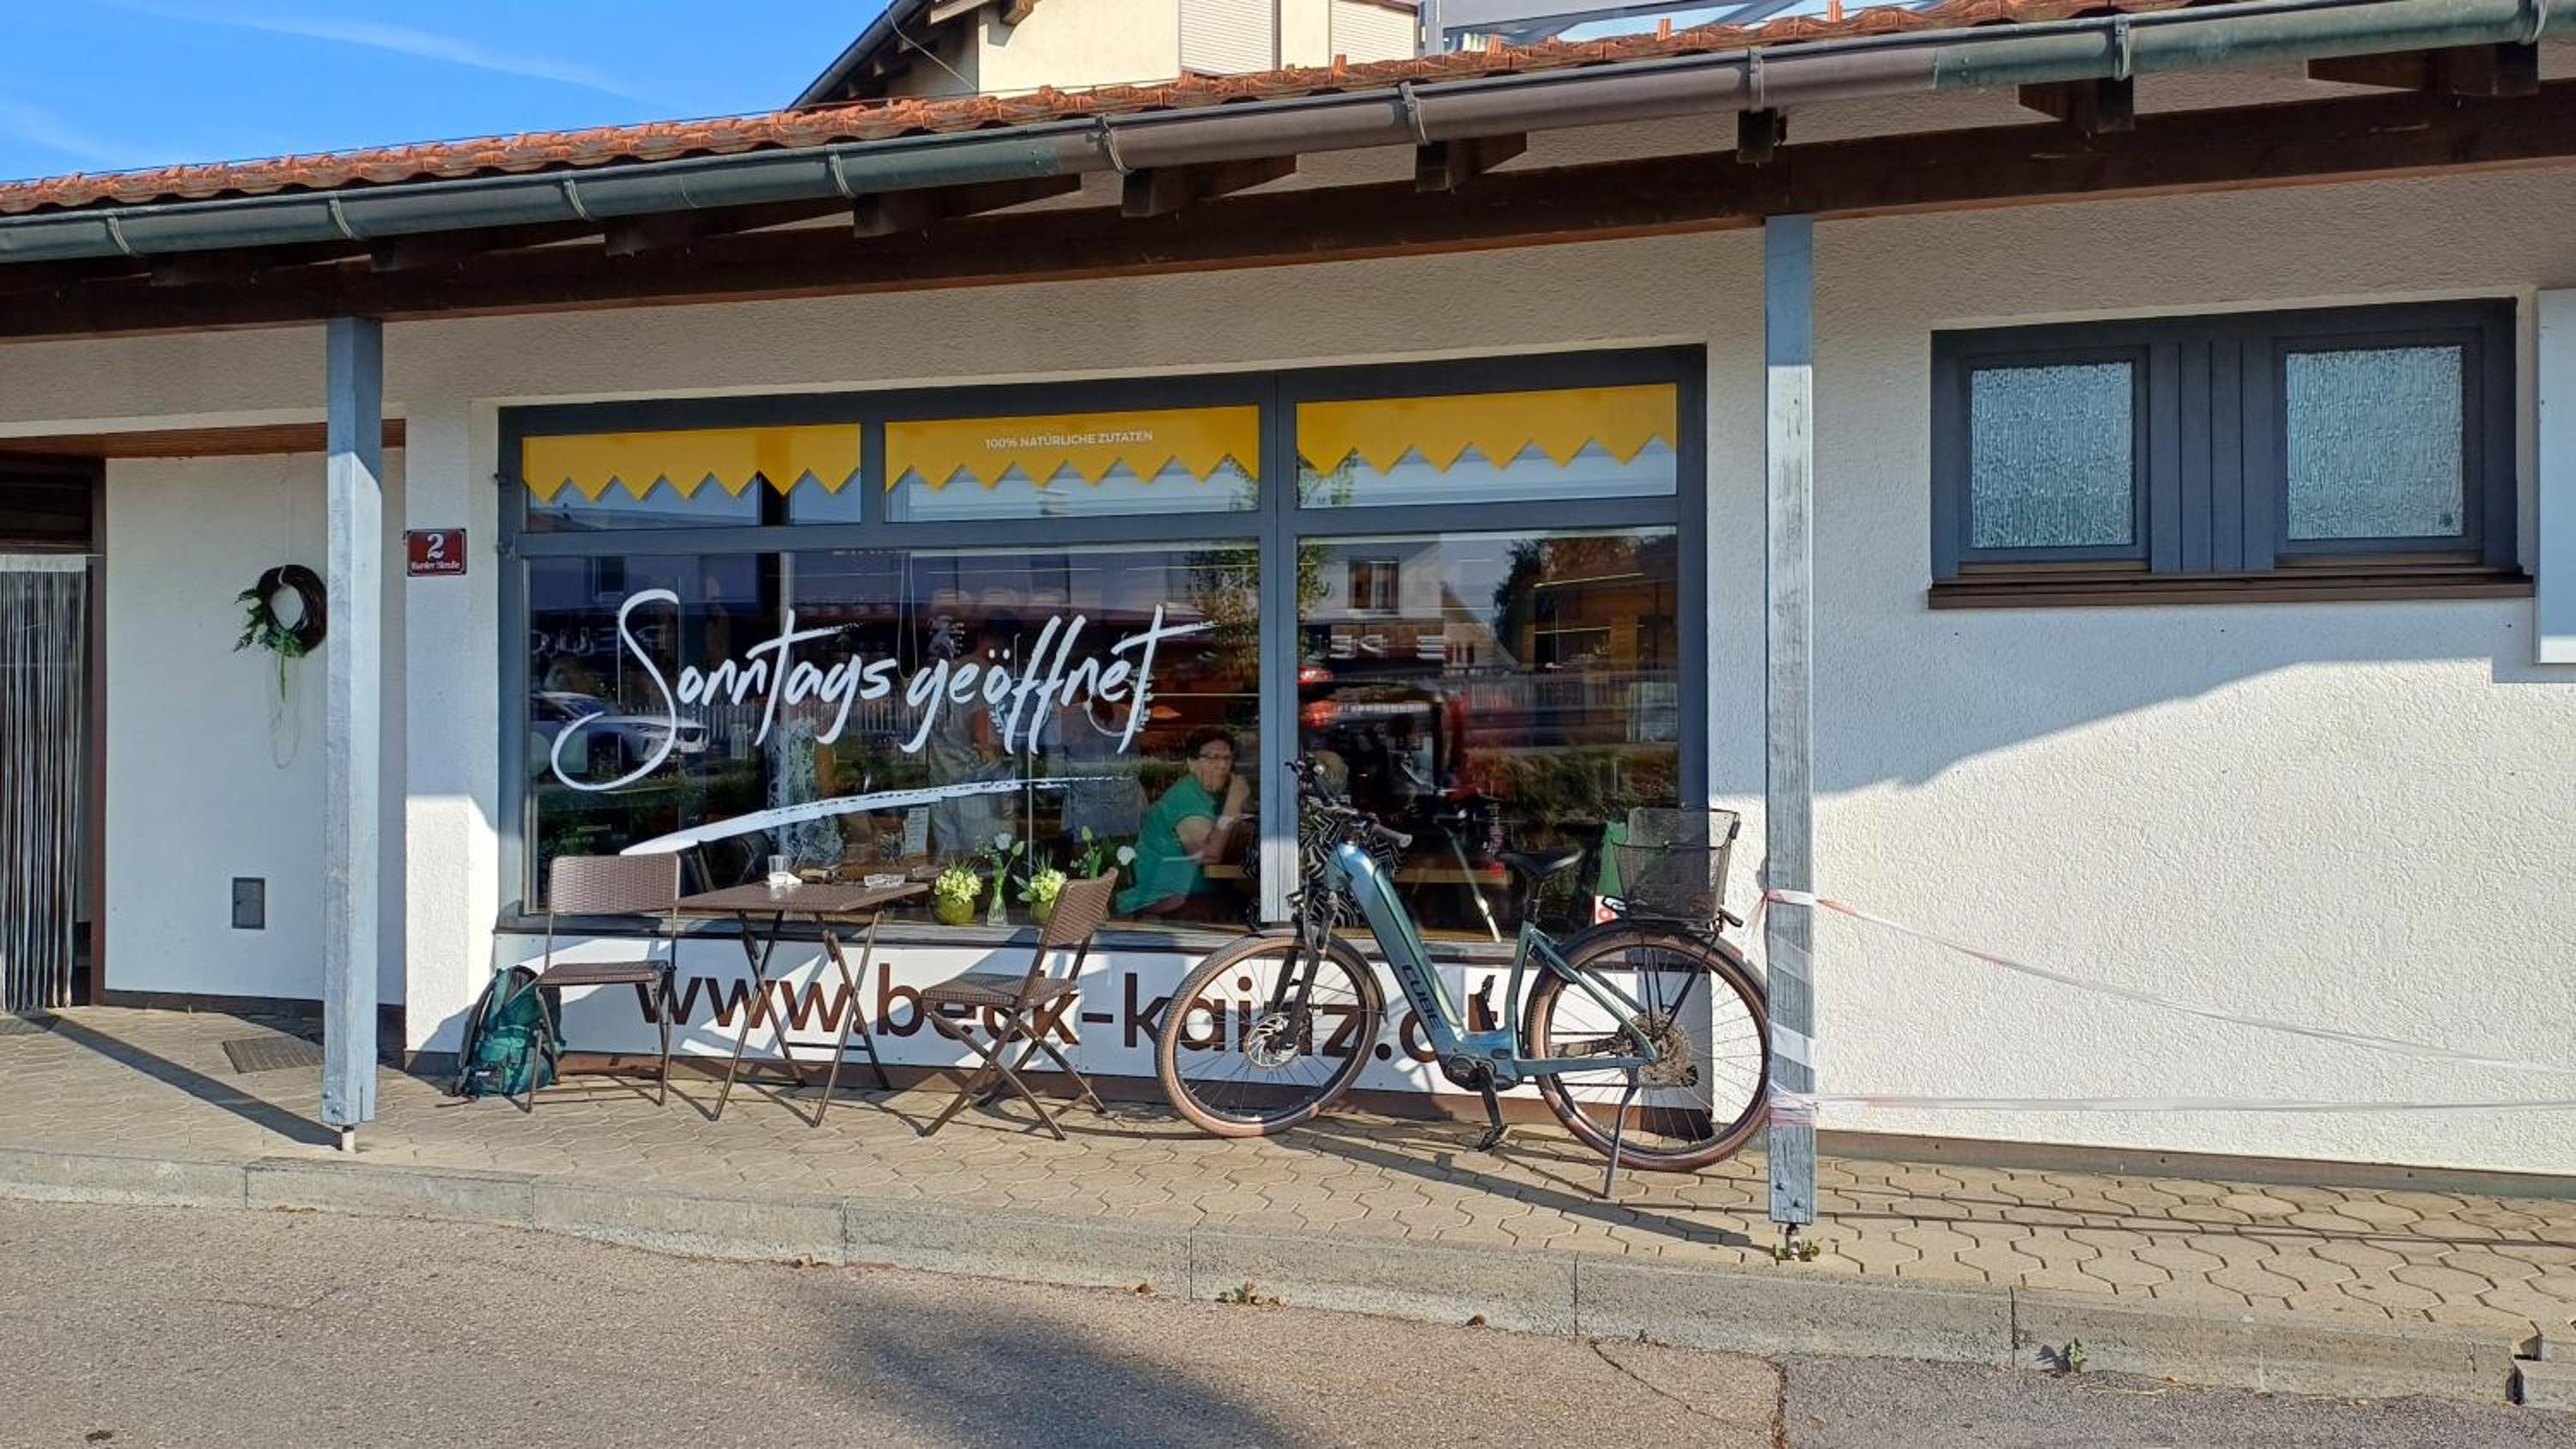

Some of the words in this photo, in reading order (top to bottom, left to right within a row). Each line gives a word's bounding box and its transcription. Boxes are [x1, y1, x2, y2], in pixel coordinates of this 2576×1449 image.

[986, 438, 1018, 450] 100%
[1019, 432, 1097, 447] NATÜRLICHE
[1098, 430, 1154, 443] ZUTATEN
[427, 533, 445, 560] 2
[550, 589, 896, 791] Sonntags
[899, 603, 1219, 755] geöffnet
[1401, 964, 1443, 1029] CUBE
